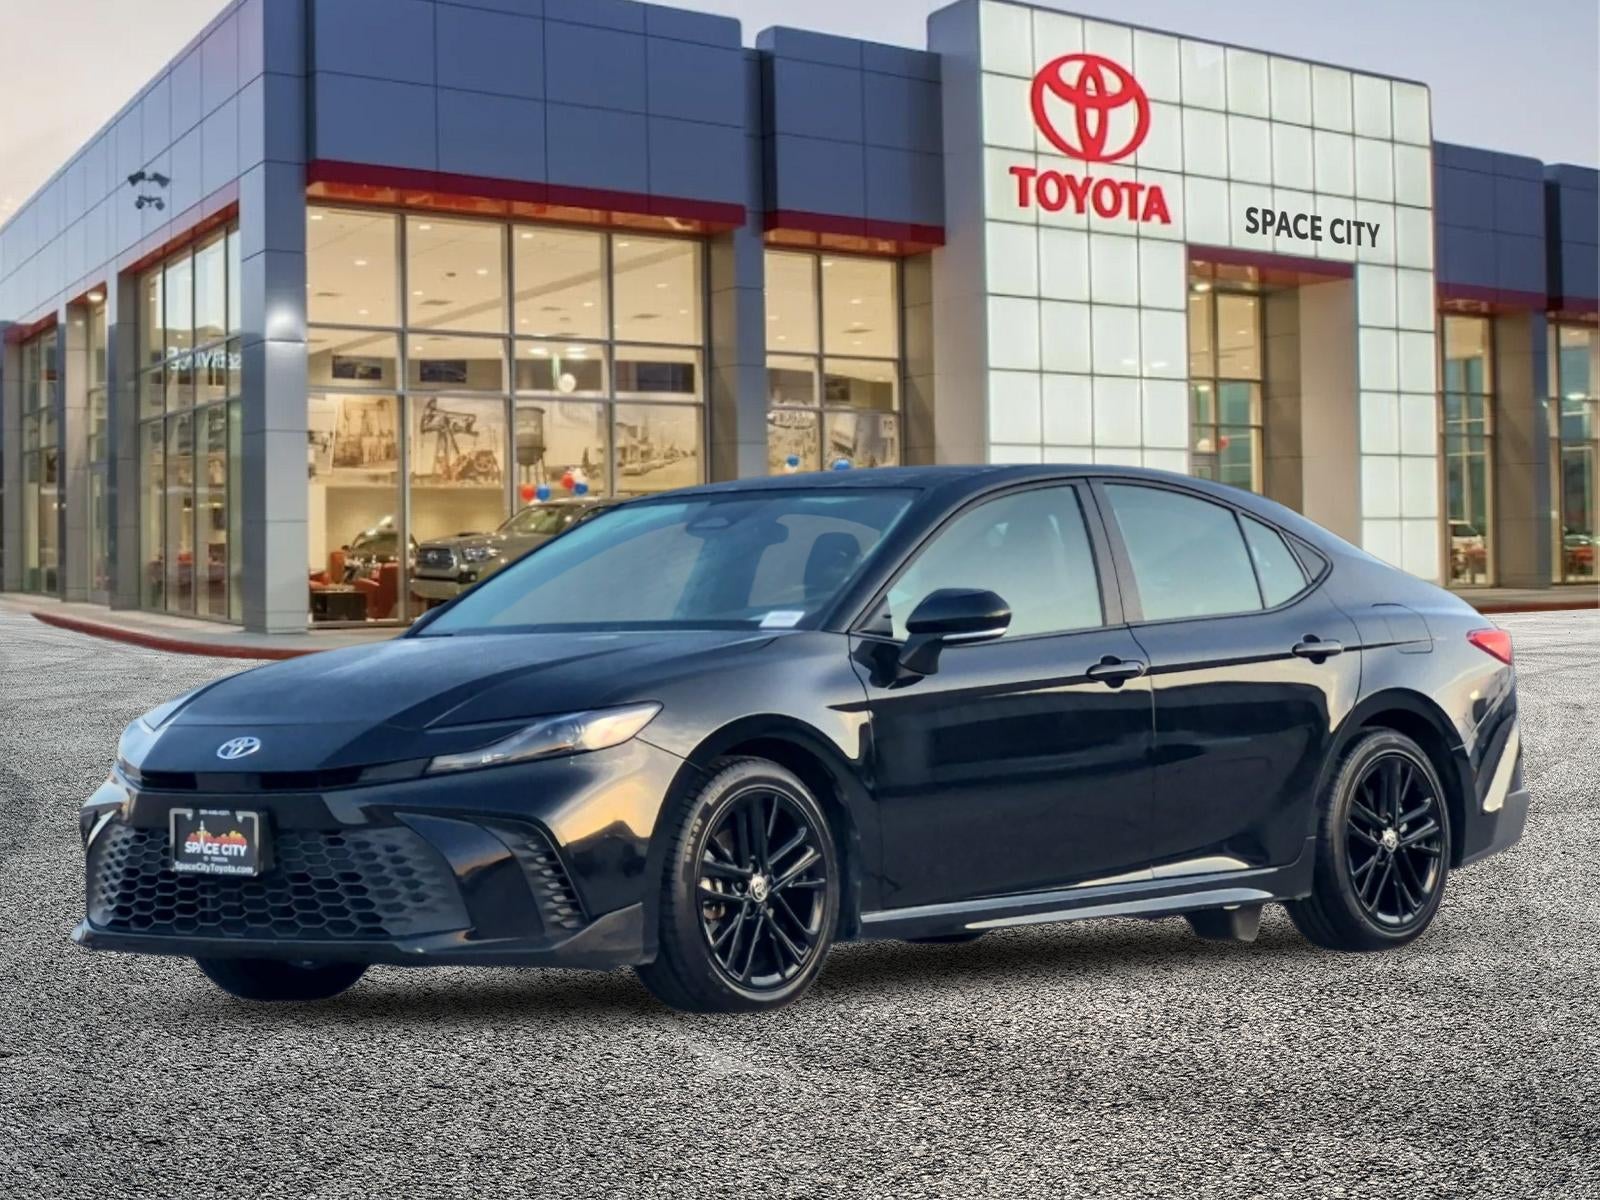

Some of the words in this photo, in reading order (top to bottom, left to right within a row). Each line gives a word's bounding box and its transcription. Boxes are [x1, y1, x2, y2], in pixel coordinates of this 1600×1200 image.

[1009, 166, 1171, 225] TOYOTA
[1245, 206, 1323, 242] SPACE
[1329, 218, 1381, 248] CITY
[184, 841, 220, 854] SPACE
[221, 843, 247, 856] CITY
[174, 861, 254, 874] SpaceCityToyota.com
